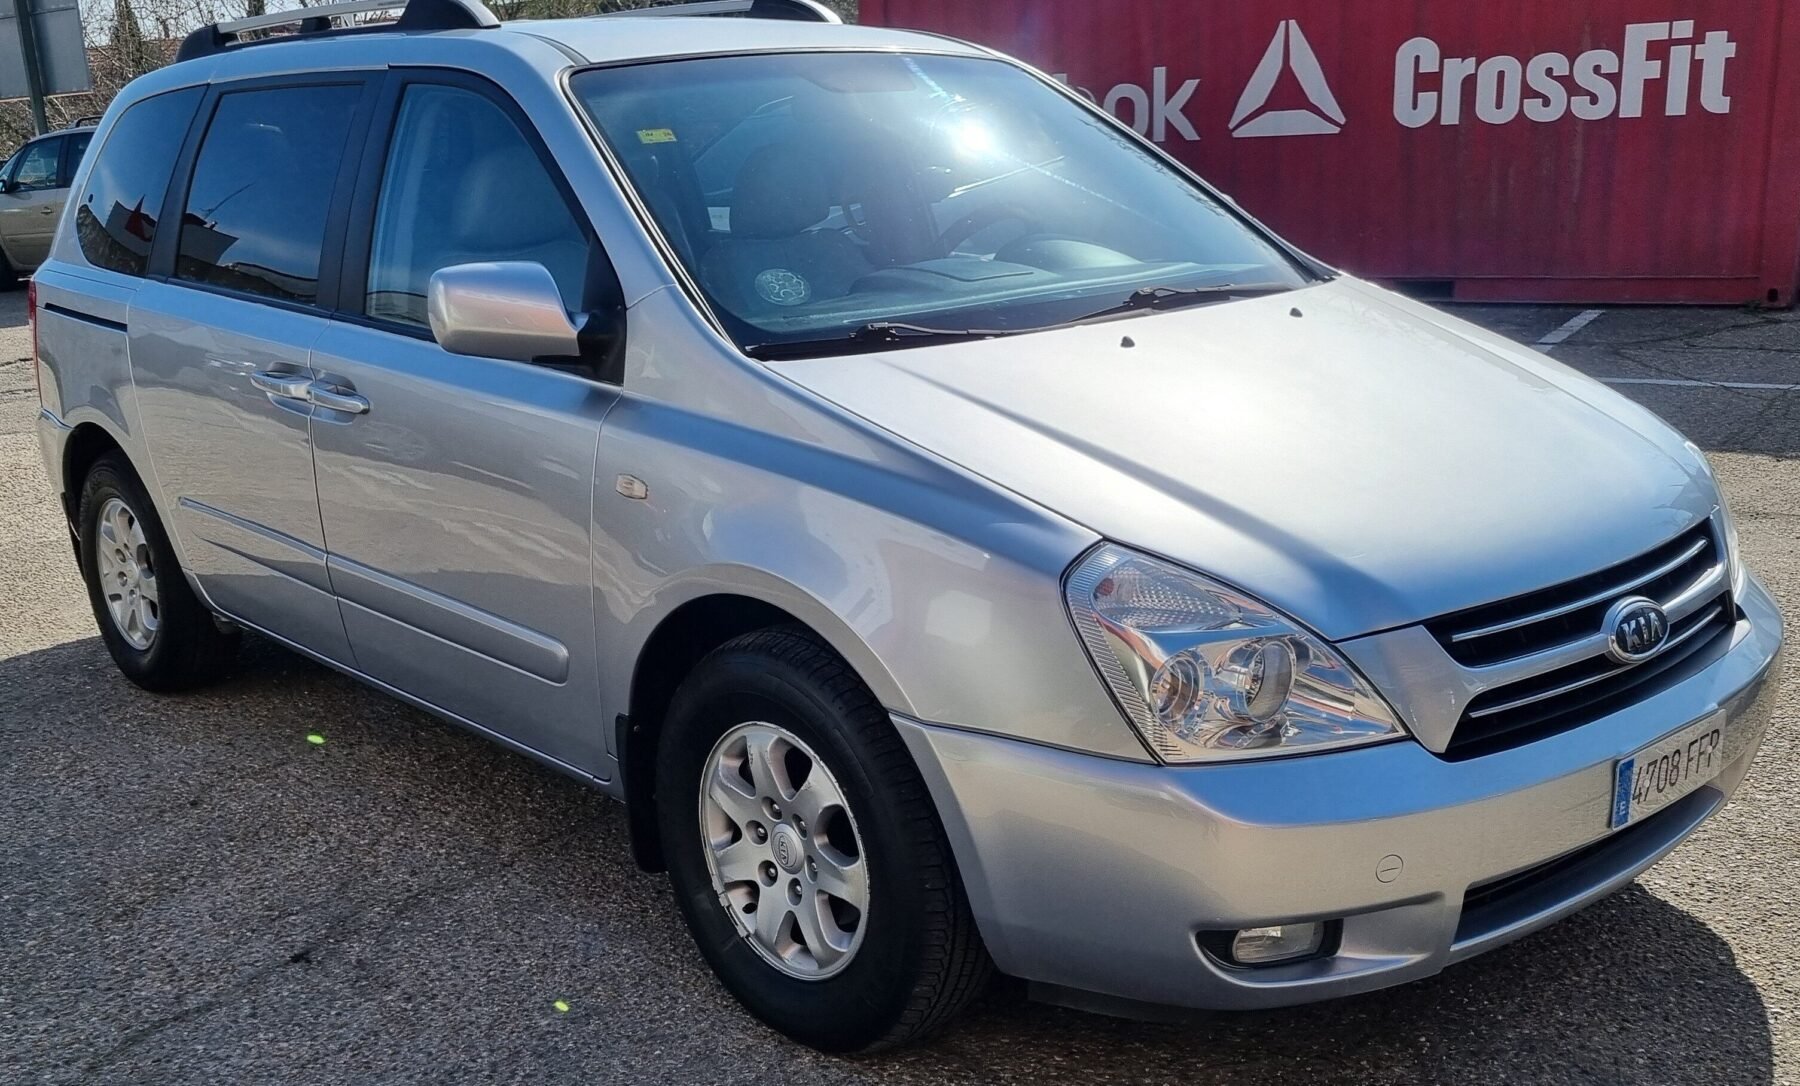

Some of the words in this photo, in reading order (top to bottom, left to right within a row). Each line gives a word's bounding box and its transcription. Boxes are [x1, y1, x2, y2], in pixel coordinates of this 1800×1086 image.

[1393, 20, 1736, 129] CrossFit
[1621, 612, 1663, 651] KIA
[1632, 749, 1681, 805] 4708
[1685, 729, 1720, 780] FFP
